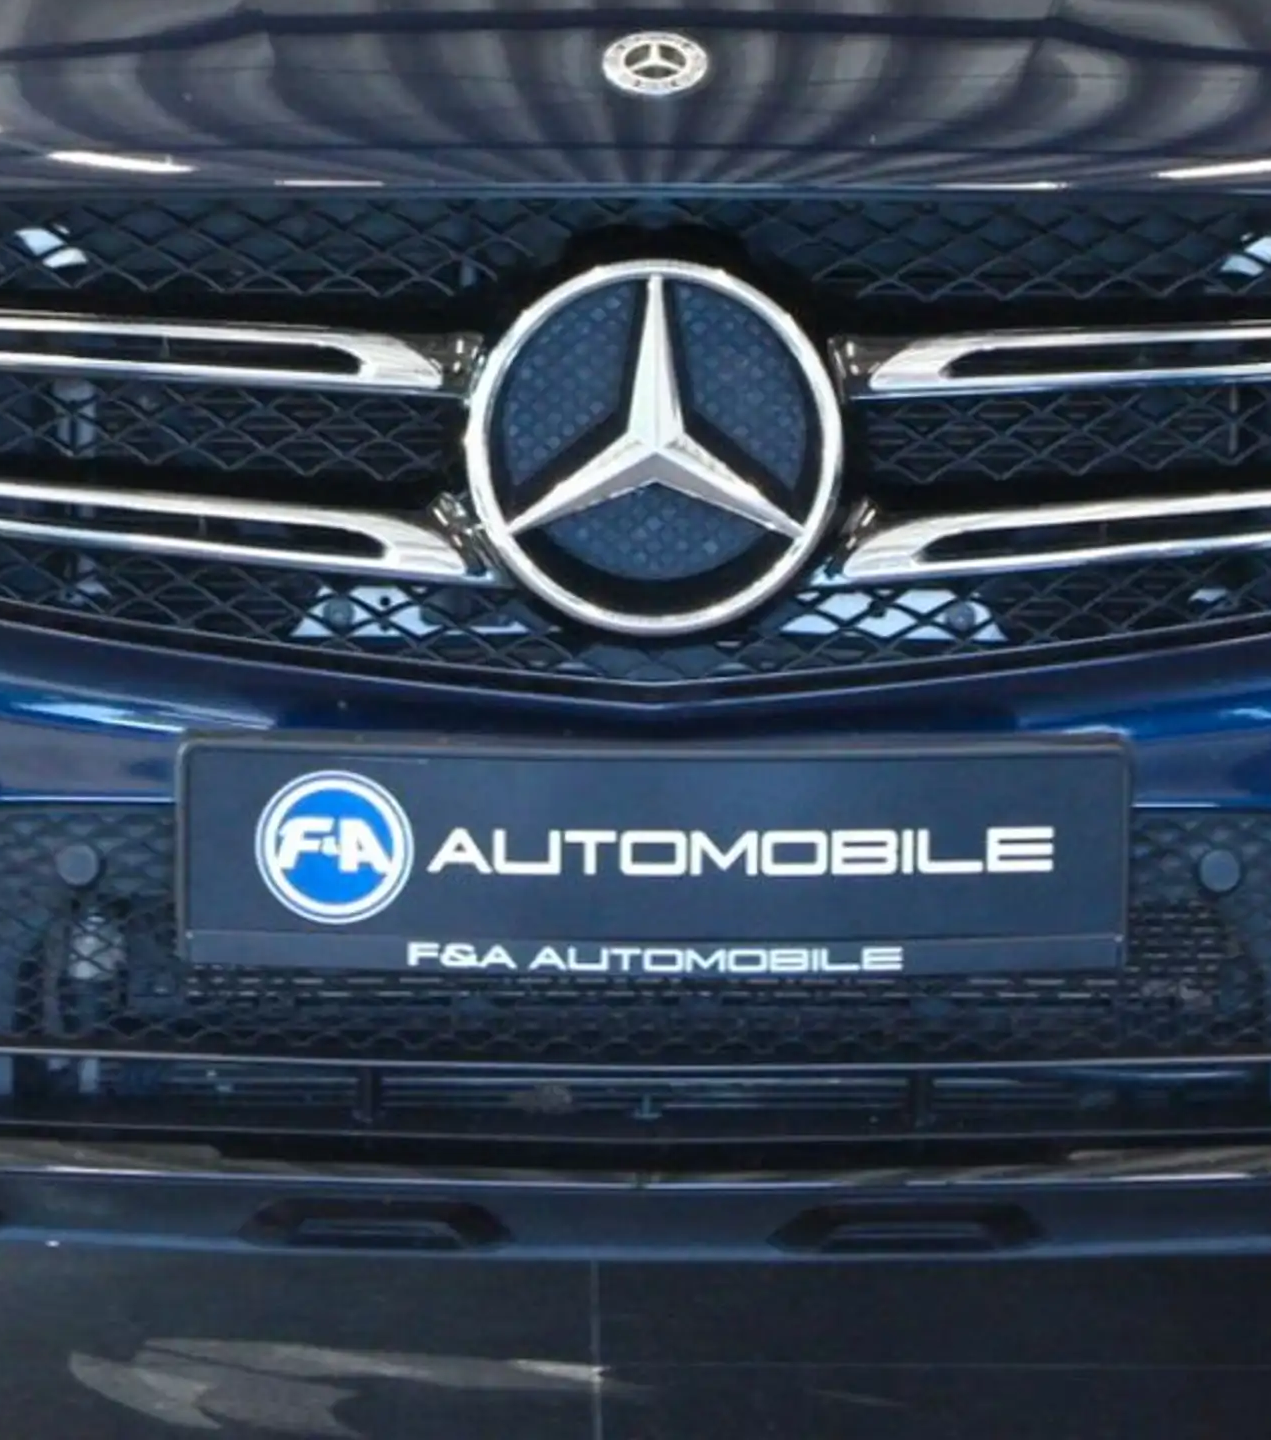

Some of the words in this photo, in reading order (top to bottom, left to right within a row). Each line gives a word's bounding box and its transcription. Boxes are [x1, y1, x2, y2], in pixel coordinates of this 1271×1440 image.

[427, 826, 1054, 876] AUTOMOBILE
[407, 940, 517, 969] F&A
[528, 945, 903, 973] AUTOMOBILE
